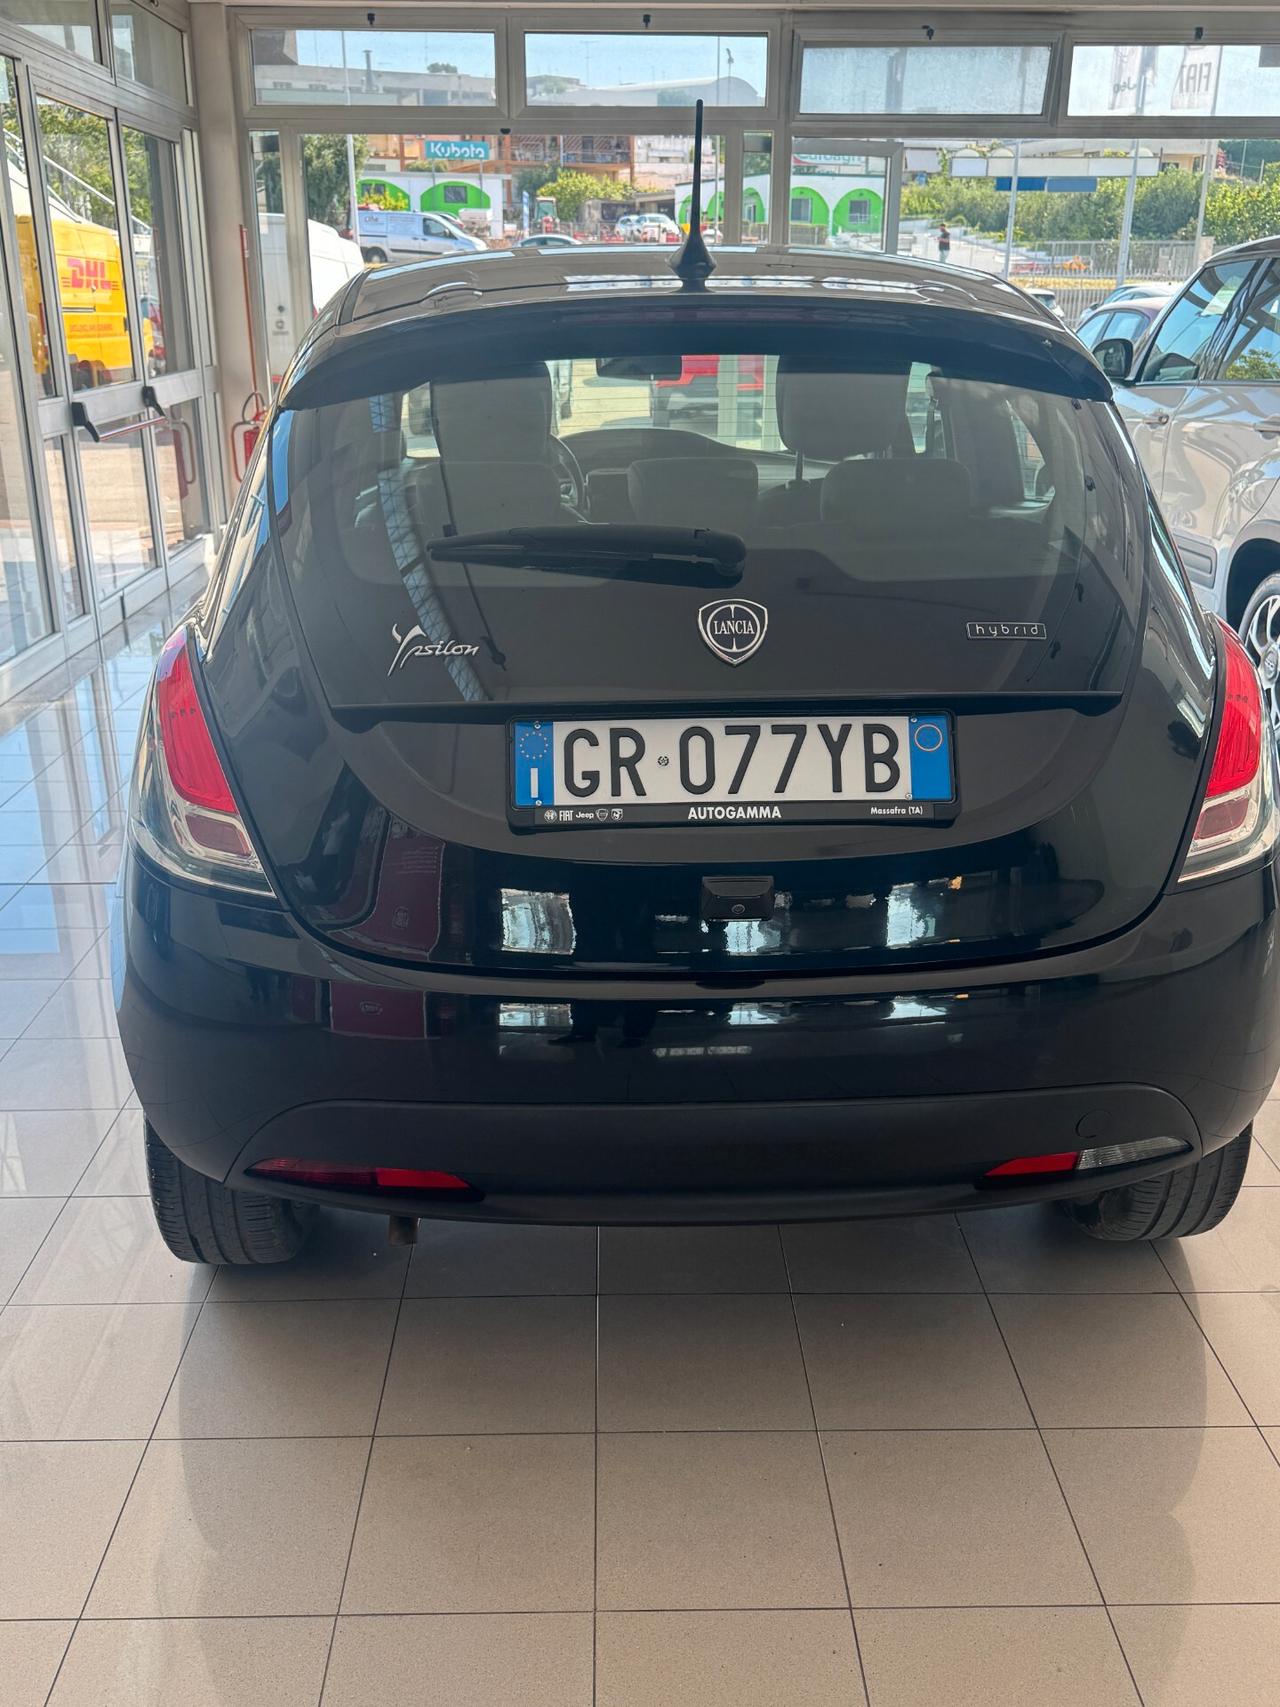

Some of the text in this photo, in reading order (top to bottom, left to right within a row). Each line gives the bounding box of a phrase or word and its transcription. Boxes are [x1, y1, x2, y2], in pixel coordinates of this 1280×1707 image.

[430, 142, 485, 158] Kubota
[67, 257, 112, 290] DHL
[713, 620, 755, 635] LANCIA
[975, 624, 1039, 637] hybrid
[387, 623, 480, 677] Ypsilon
[563, 723, 901, 798] GR 077YB
[559, 810, 574, 822] FIAT
[575, 811, 595, 820] Jeep
[688, 806, 782, 821] AUTOGAMMA
[870, 806, 924, 815] Massafra (TA)
